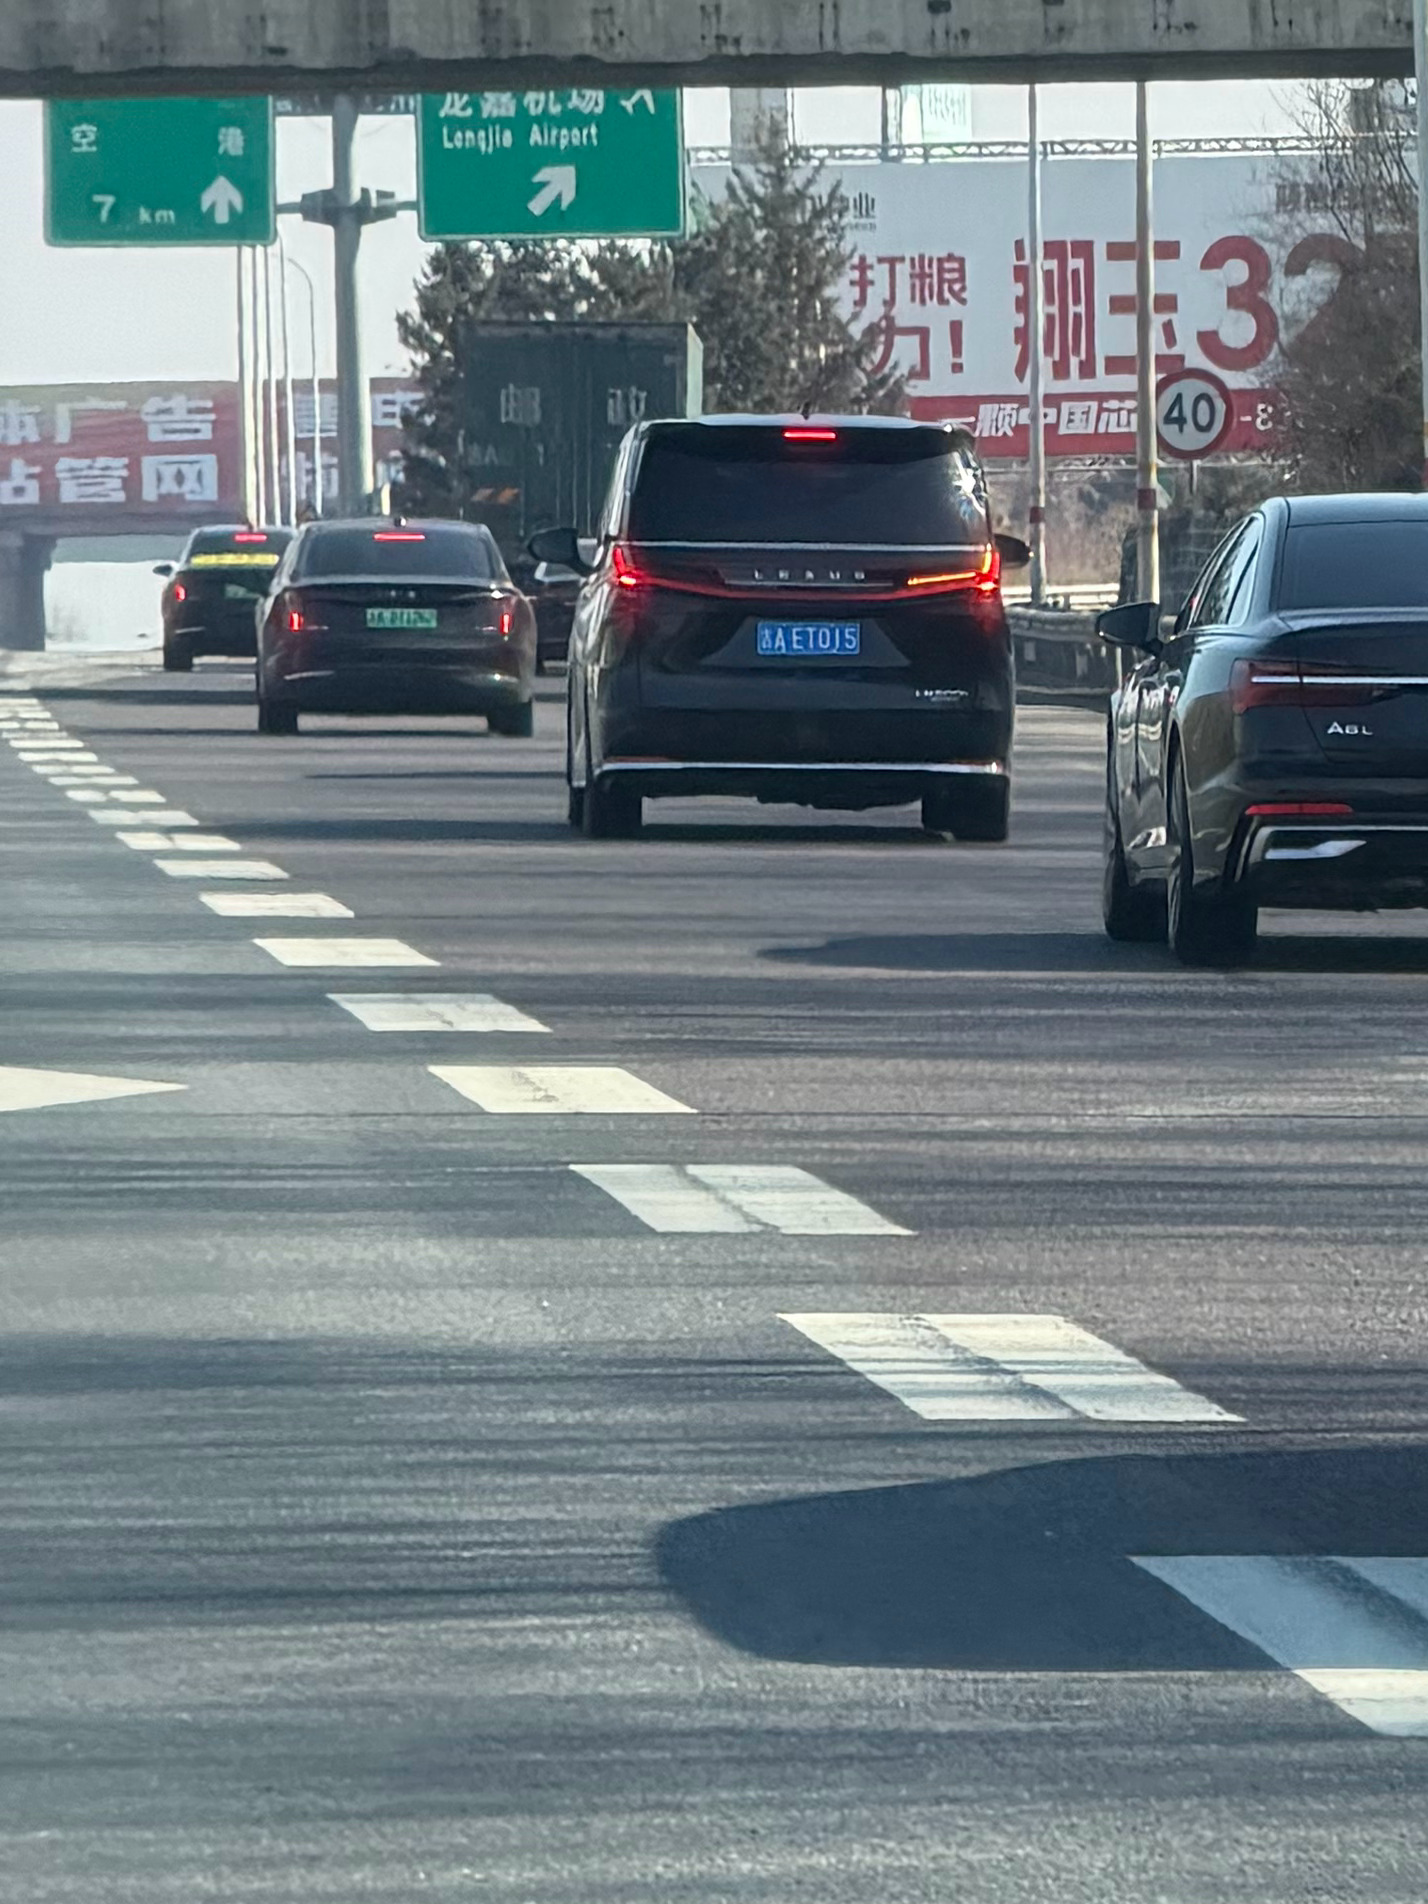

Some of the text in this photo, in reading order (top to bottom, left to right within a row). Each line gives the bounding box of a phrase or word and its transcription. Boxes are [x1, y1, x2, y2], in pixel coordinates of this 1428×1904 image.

[529, 122, 598, 151] Airport
[92, 194, 176, 225] 7 km
[850, 253, 968, 308] 打粮
[1163, 392, 1216, 434] 40
